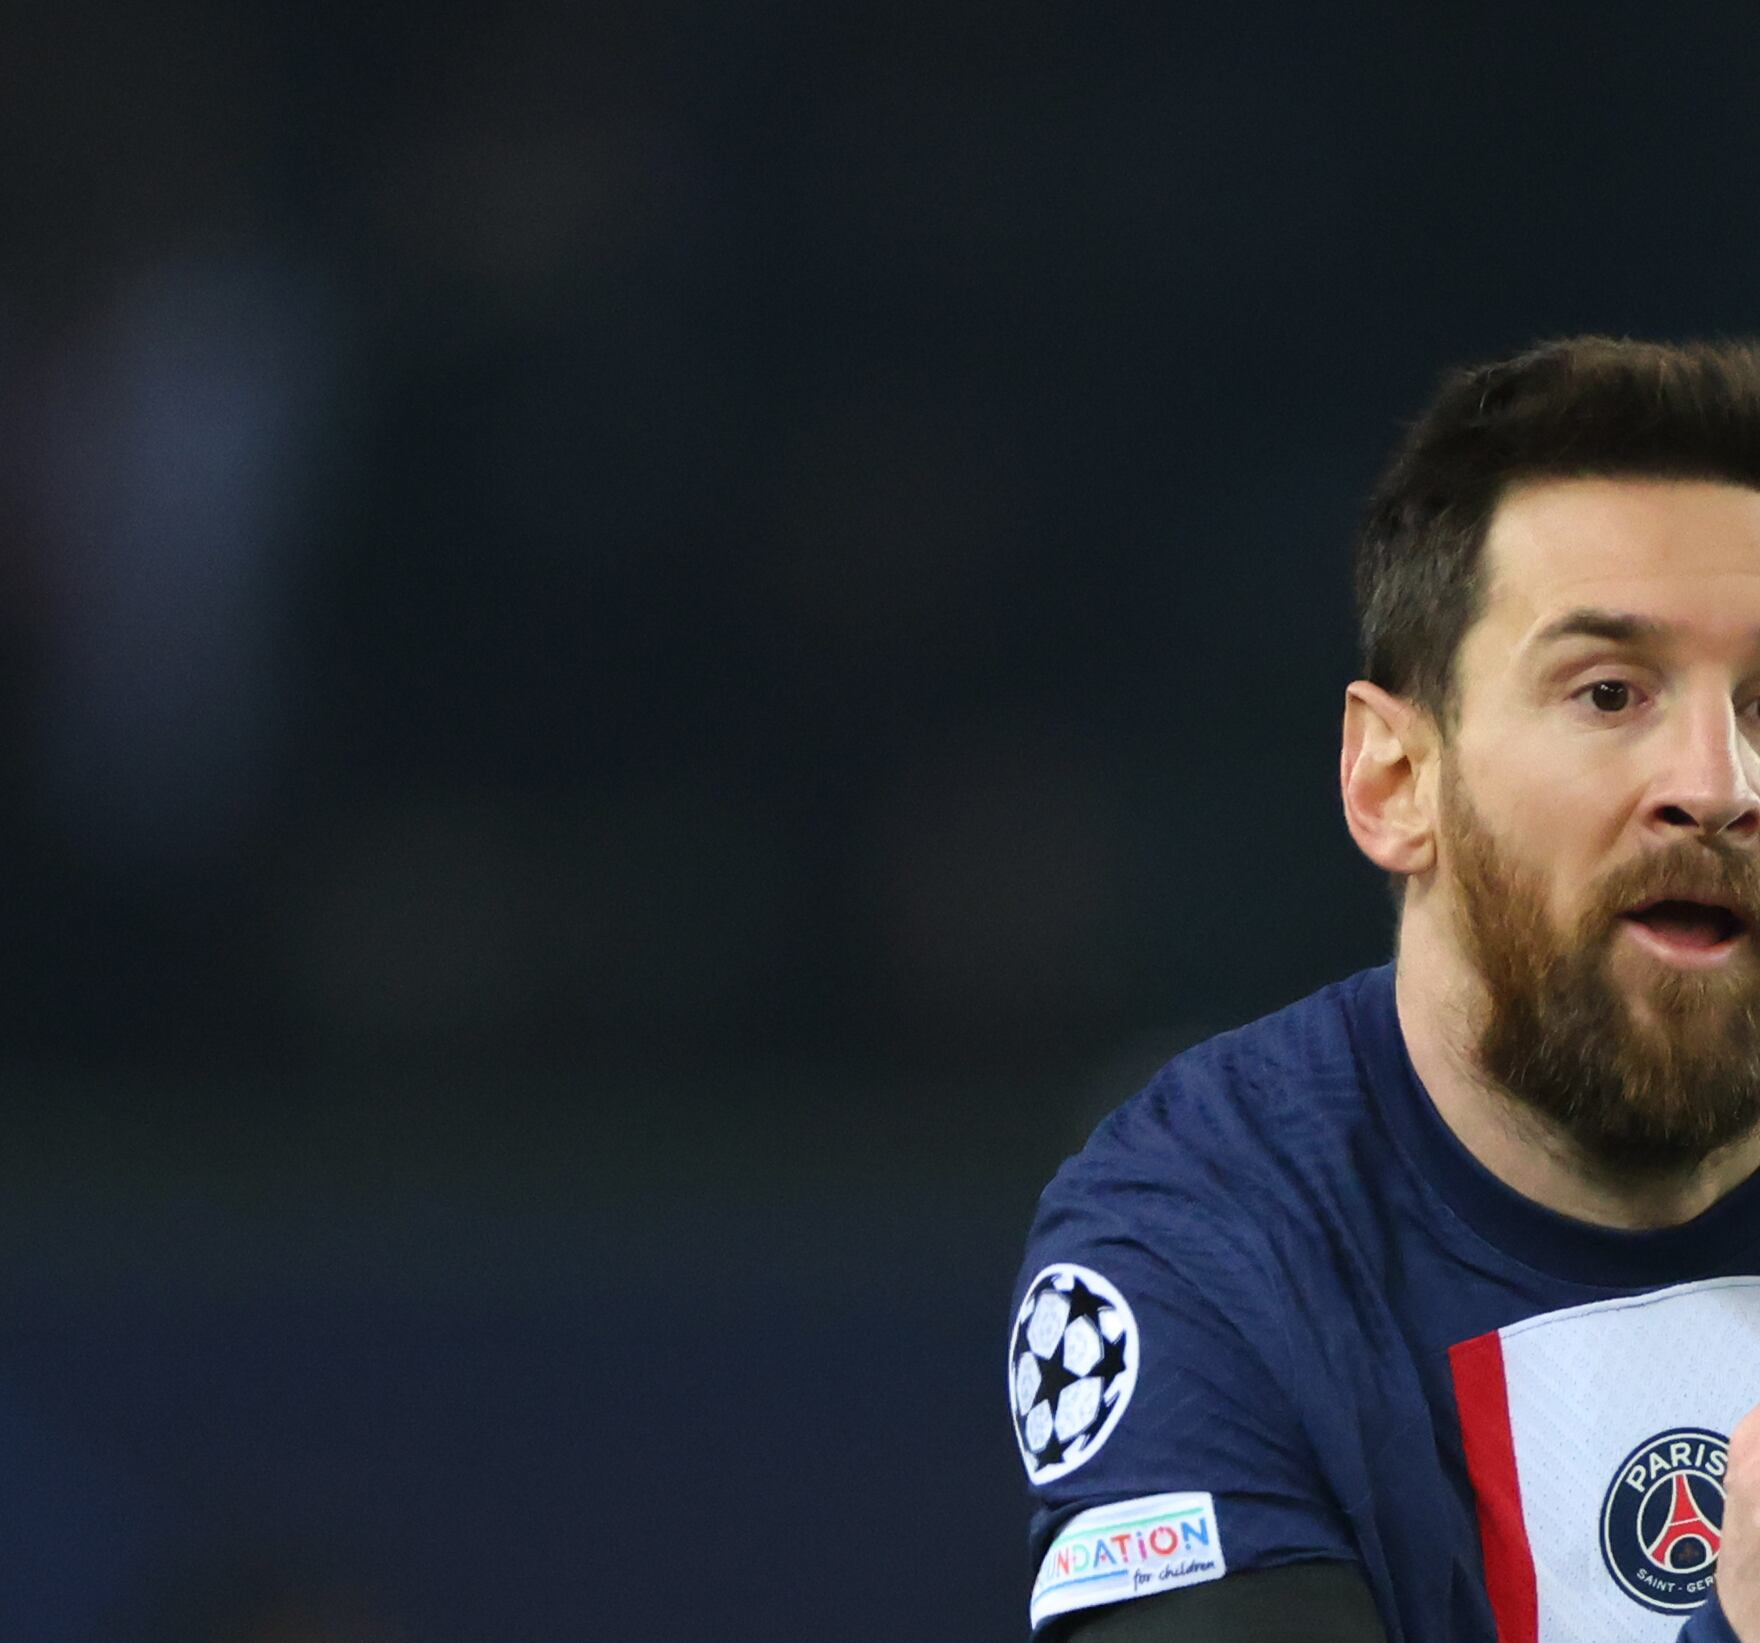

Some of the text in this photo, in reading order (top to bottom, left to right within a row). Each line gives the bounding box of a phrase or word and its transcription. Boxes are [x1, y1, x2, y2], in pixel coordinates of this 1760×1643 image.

[1625, 1442, 1729, 1493] PARIS
[1134, 1560, 1215, 1591] for children
[1636, 1568, 1676, 1593] SAINT
